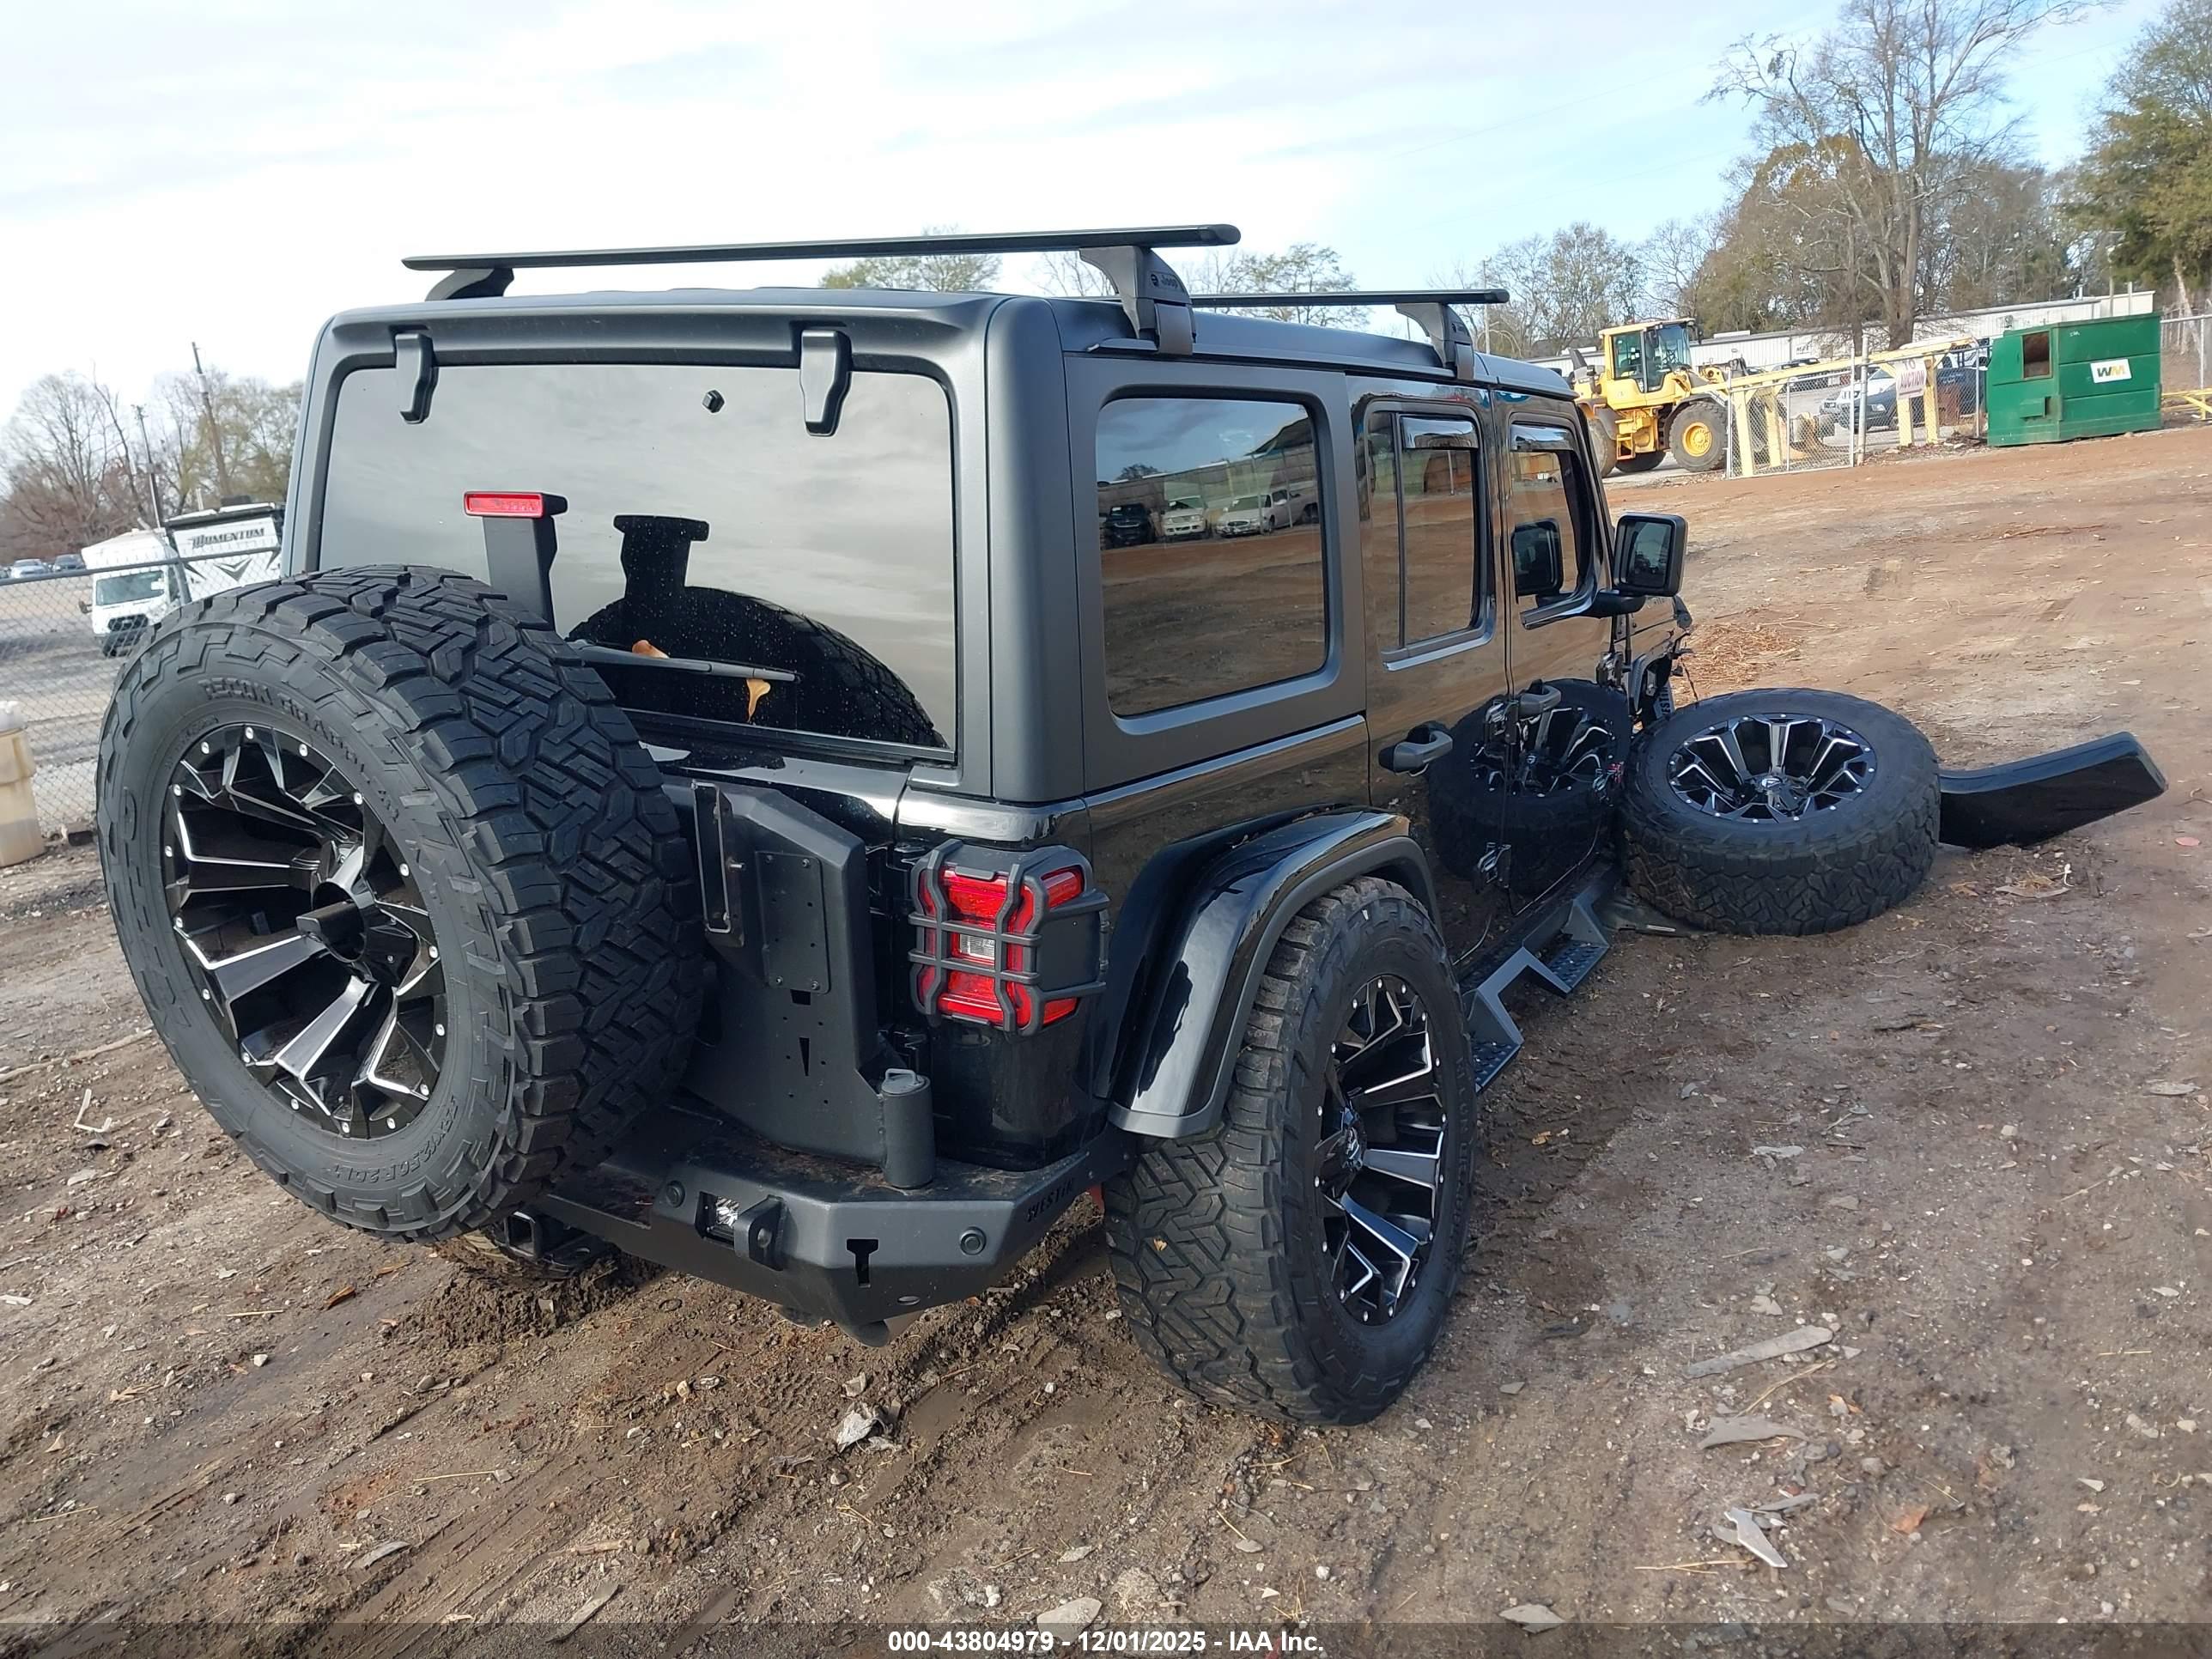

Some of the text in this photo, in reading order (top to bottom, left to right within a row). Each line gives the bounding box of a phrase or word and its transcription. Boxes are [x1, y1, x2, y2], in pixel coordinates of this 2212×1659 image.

[1902, 358, 1917, 370] TO
[2096, 365, 2127, 378] WM
[1900, 370, 1924, 388] AUCTION
[191, 528, 265, 550] MOMENTUM
